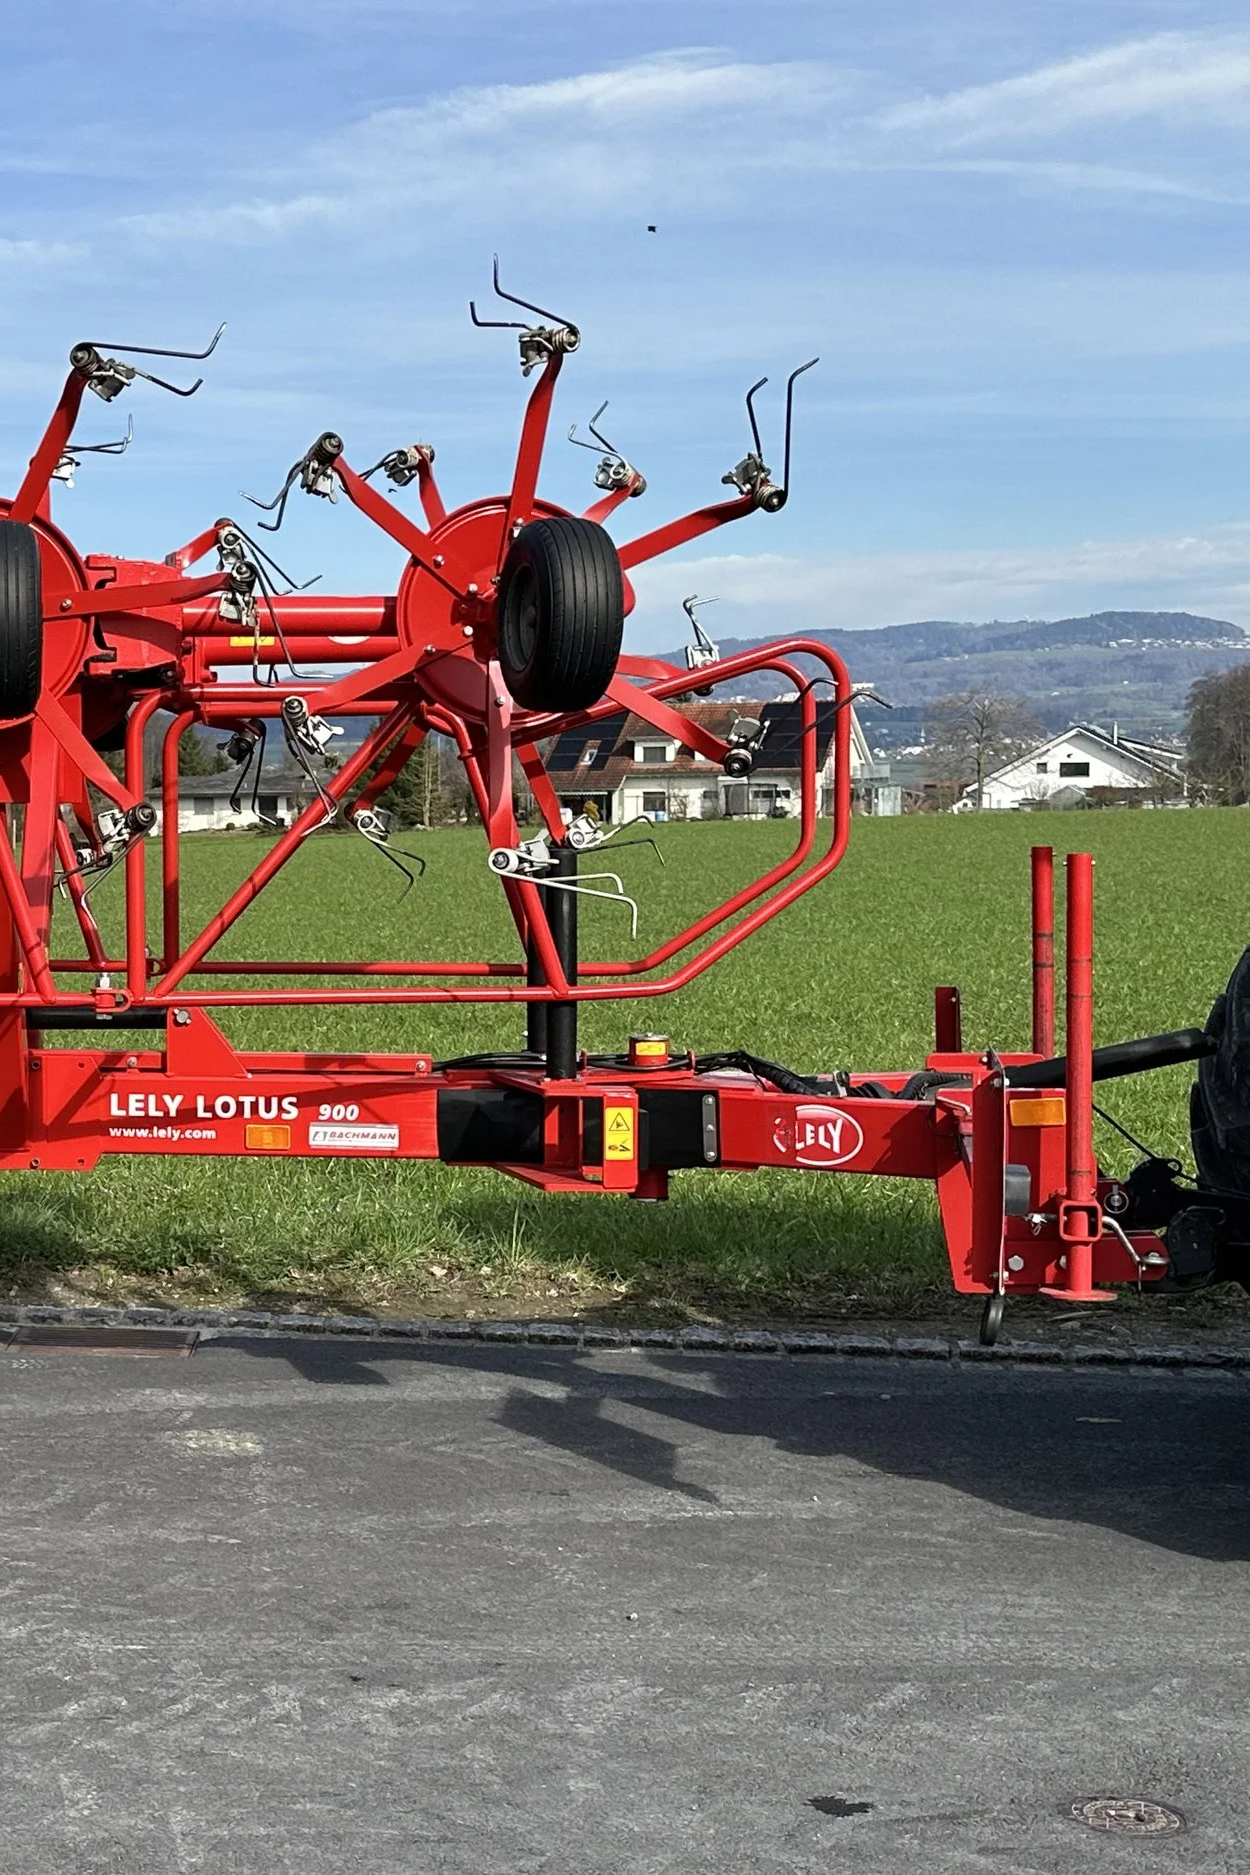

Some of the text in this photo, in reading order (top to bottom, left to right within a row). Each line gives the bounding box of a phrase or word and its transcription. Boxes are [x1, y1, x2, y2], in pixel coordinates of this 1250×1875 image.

[110, 1093, 360, 1121] LELY LOTUS 900
[109, 1126, 216, 1141] www.lely.com
[329, 1131, 397, 1141] BACHMANN
[795, 1118, 843, 1154] LELY
